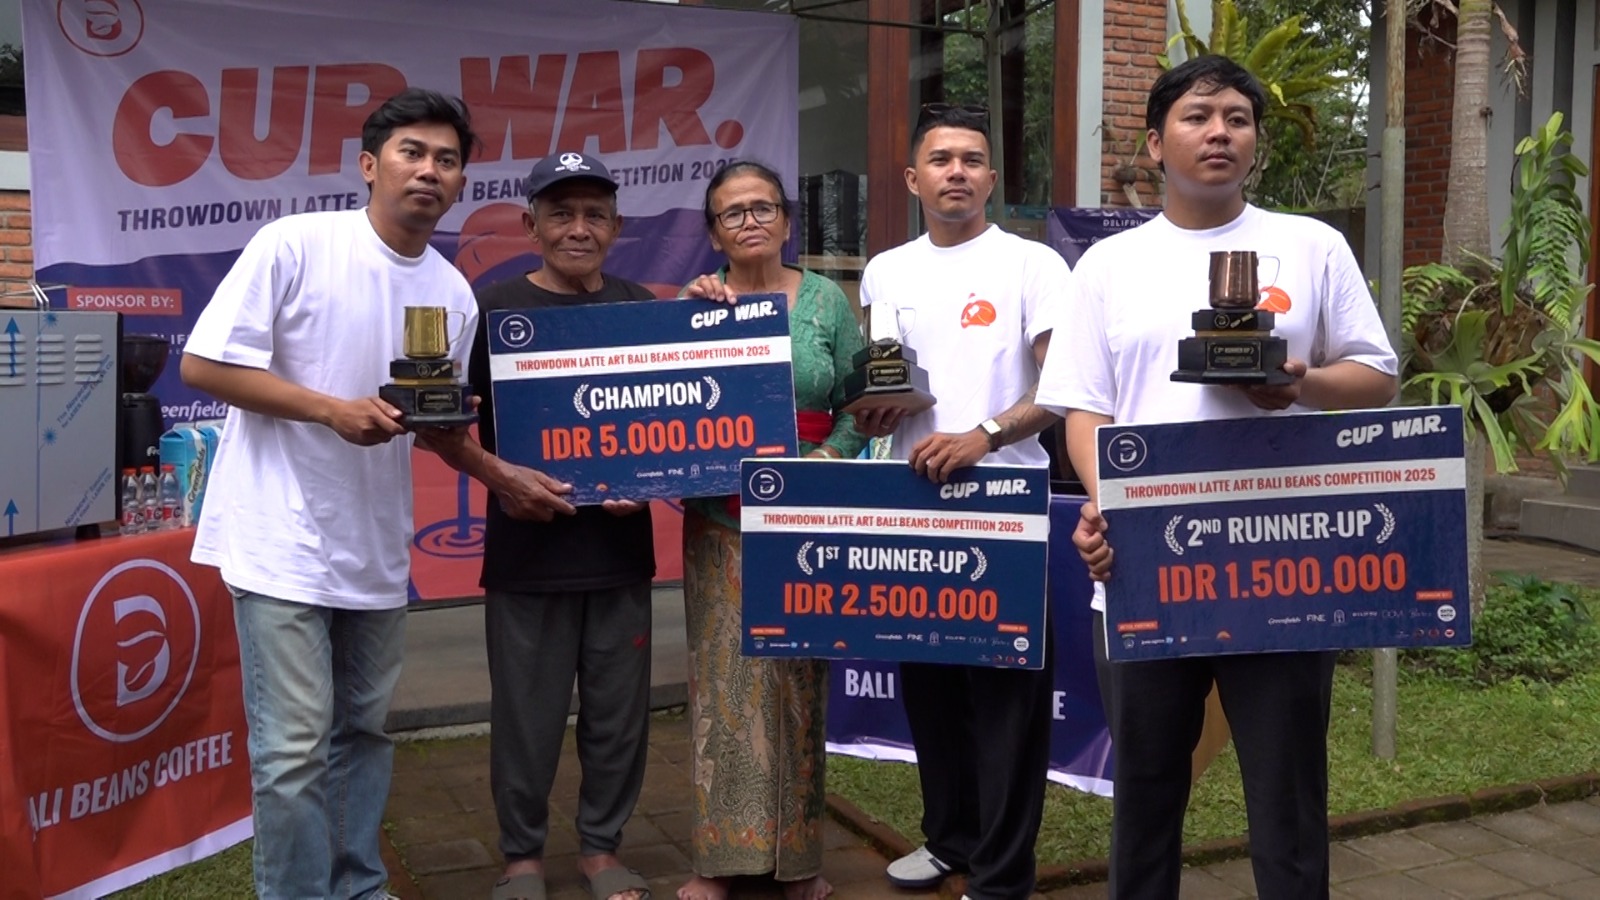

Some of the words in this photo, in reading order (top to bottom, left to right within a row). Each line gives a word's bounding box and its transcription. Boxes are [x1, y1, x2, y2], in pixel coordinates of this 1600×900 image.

[112, 63, 407, 187] CUP
[460, 47, 744, 164] WAR.
[118, 199, 282, 232] THROWDOWN
[472, 177, 528, 202] BEAN
[610, 163, 684, 186] ETITION
[76, 294, 146, 308] SPONSOR
[151, 295, 174, 308] BY:
[691, 308, 728, 329] CUP
[735, 301, 778, 321] WAR.
[515, 357, 577, 372] THROWDOWN
[579, 355, 606, 368] LATTE
[608, 354, 625, 366] ART
[627, 353, 648, 365] BALI
[651, 351, 680, 363] BEANS
[682, 347, 744, 361] COMPETITION
[746, 345, 771, 357] 2025
[161, 400, 229, 421] eenfield
[590, 381, 702, 411] CHAMPION
[542, 427, 592, 460] IDR
[600, 415, 754, 457] 5.000.000
[1336, 424, 1383, 448] CUP
[1392, 415, 1446, 438] WAR.
[940, 481, 979, 500] CUP
[986, 479, 1031, 497] WAR.
[1124, 482, 1197, 499] THROWDOWN
[1200, 479, 1230, 494] LATTE
[1233, 477, 1254, 491] ART
[1257, 476, 1282, 490] BALI
[1285, 474, 1321, 489] BEANS
[1324, 470, 1401, 487] COMPETITION
[1405, 468, 1436, 483] 2025
[763, 513, 825, 526] THROWDOWN
[827, 514, 854, 527] LATTE
[856, 515, 874, 527] ART
[876, 516, 898, 528] BALI
[899, 516, 930, 529] BEANS
[932, 517, 995, 531] COMPETITION
[998, 520, 1024, 533] 2025
[1187, 517, 1221, 547] 2ND
[1228, 509, 1372, 544] RUNNER-UP
[816, 546, 840, 569] 1ST
[848, 546, 968, 574] RUNNER-UP
[1158, 562, 1217, 603] IDR
[1225, 552, 1406, 599] 1.500.000
[784, 583, 834, 615] IDR
[841, 584, 997, 622] 2.500.000
[845, 669, 895, 699] BALI
[69, 760, 149, 820] BEANS
[154, 731, 233, 788] COFFEE
